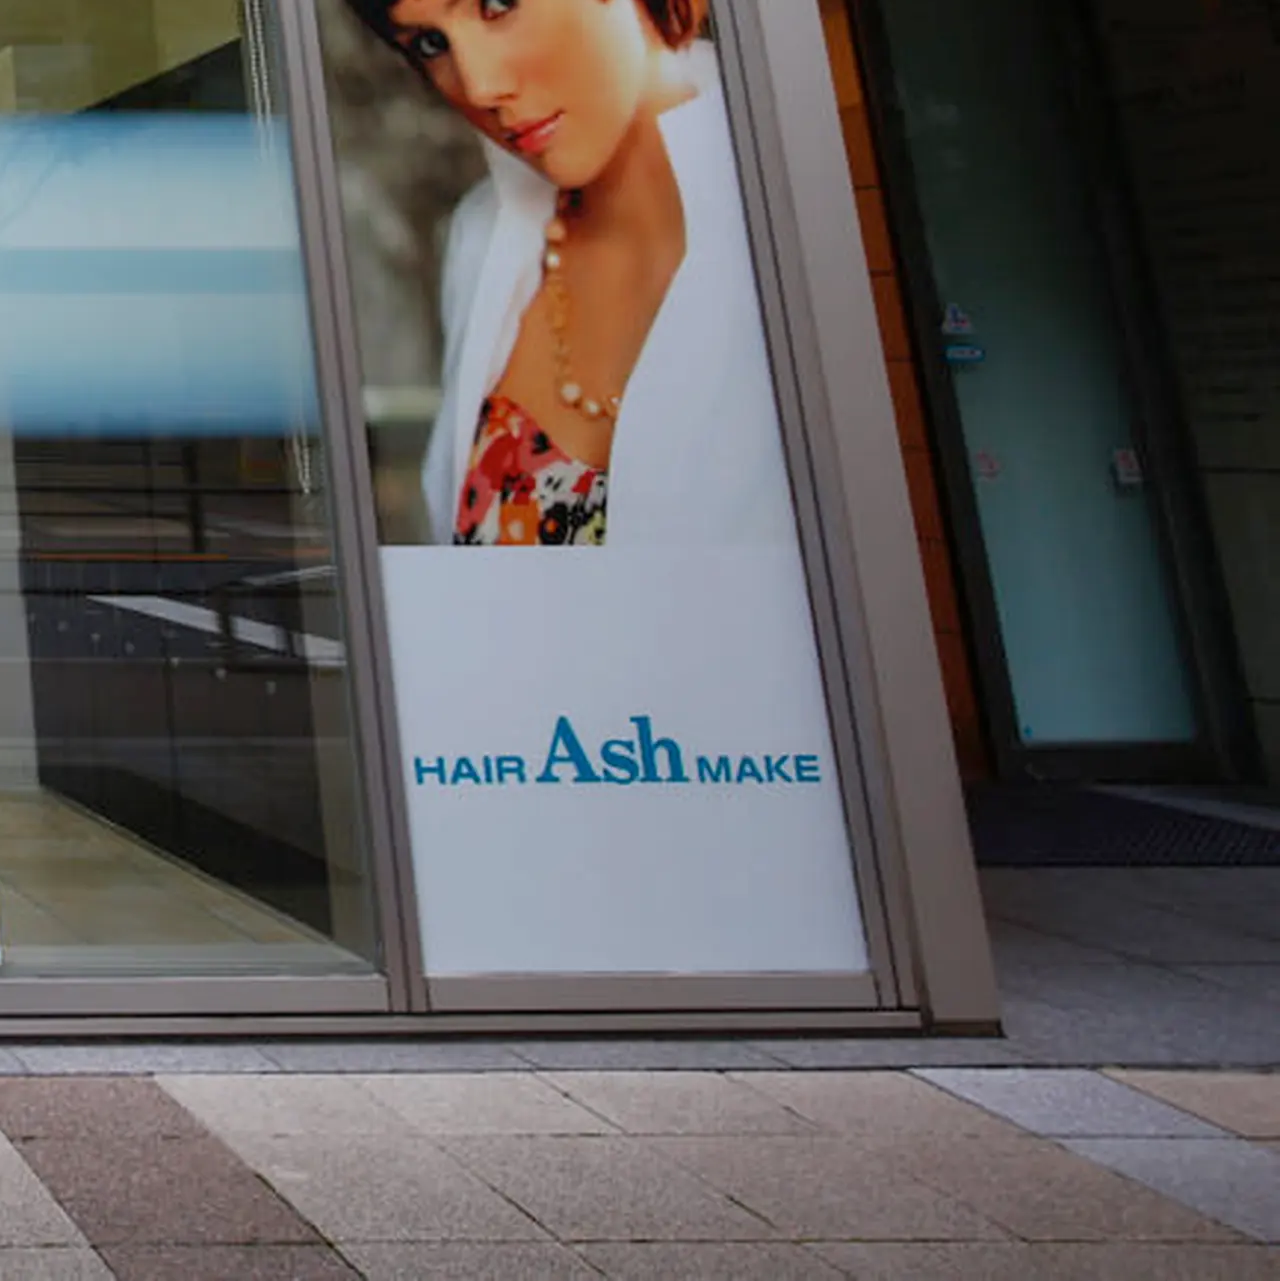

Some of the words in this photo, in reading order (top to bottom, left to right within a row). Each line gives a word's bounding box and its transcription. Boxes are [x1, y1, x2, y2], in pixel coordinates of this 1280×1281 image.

[414, 754, 527, 786] HAIR
[535, 715, 692, 786] Ash
[697, 754, 823, 785] MAKE
